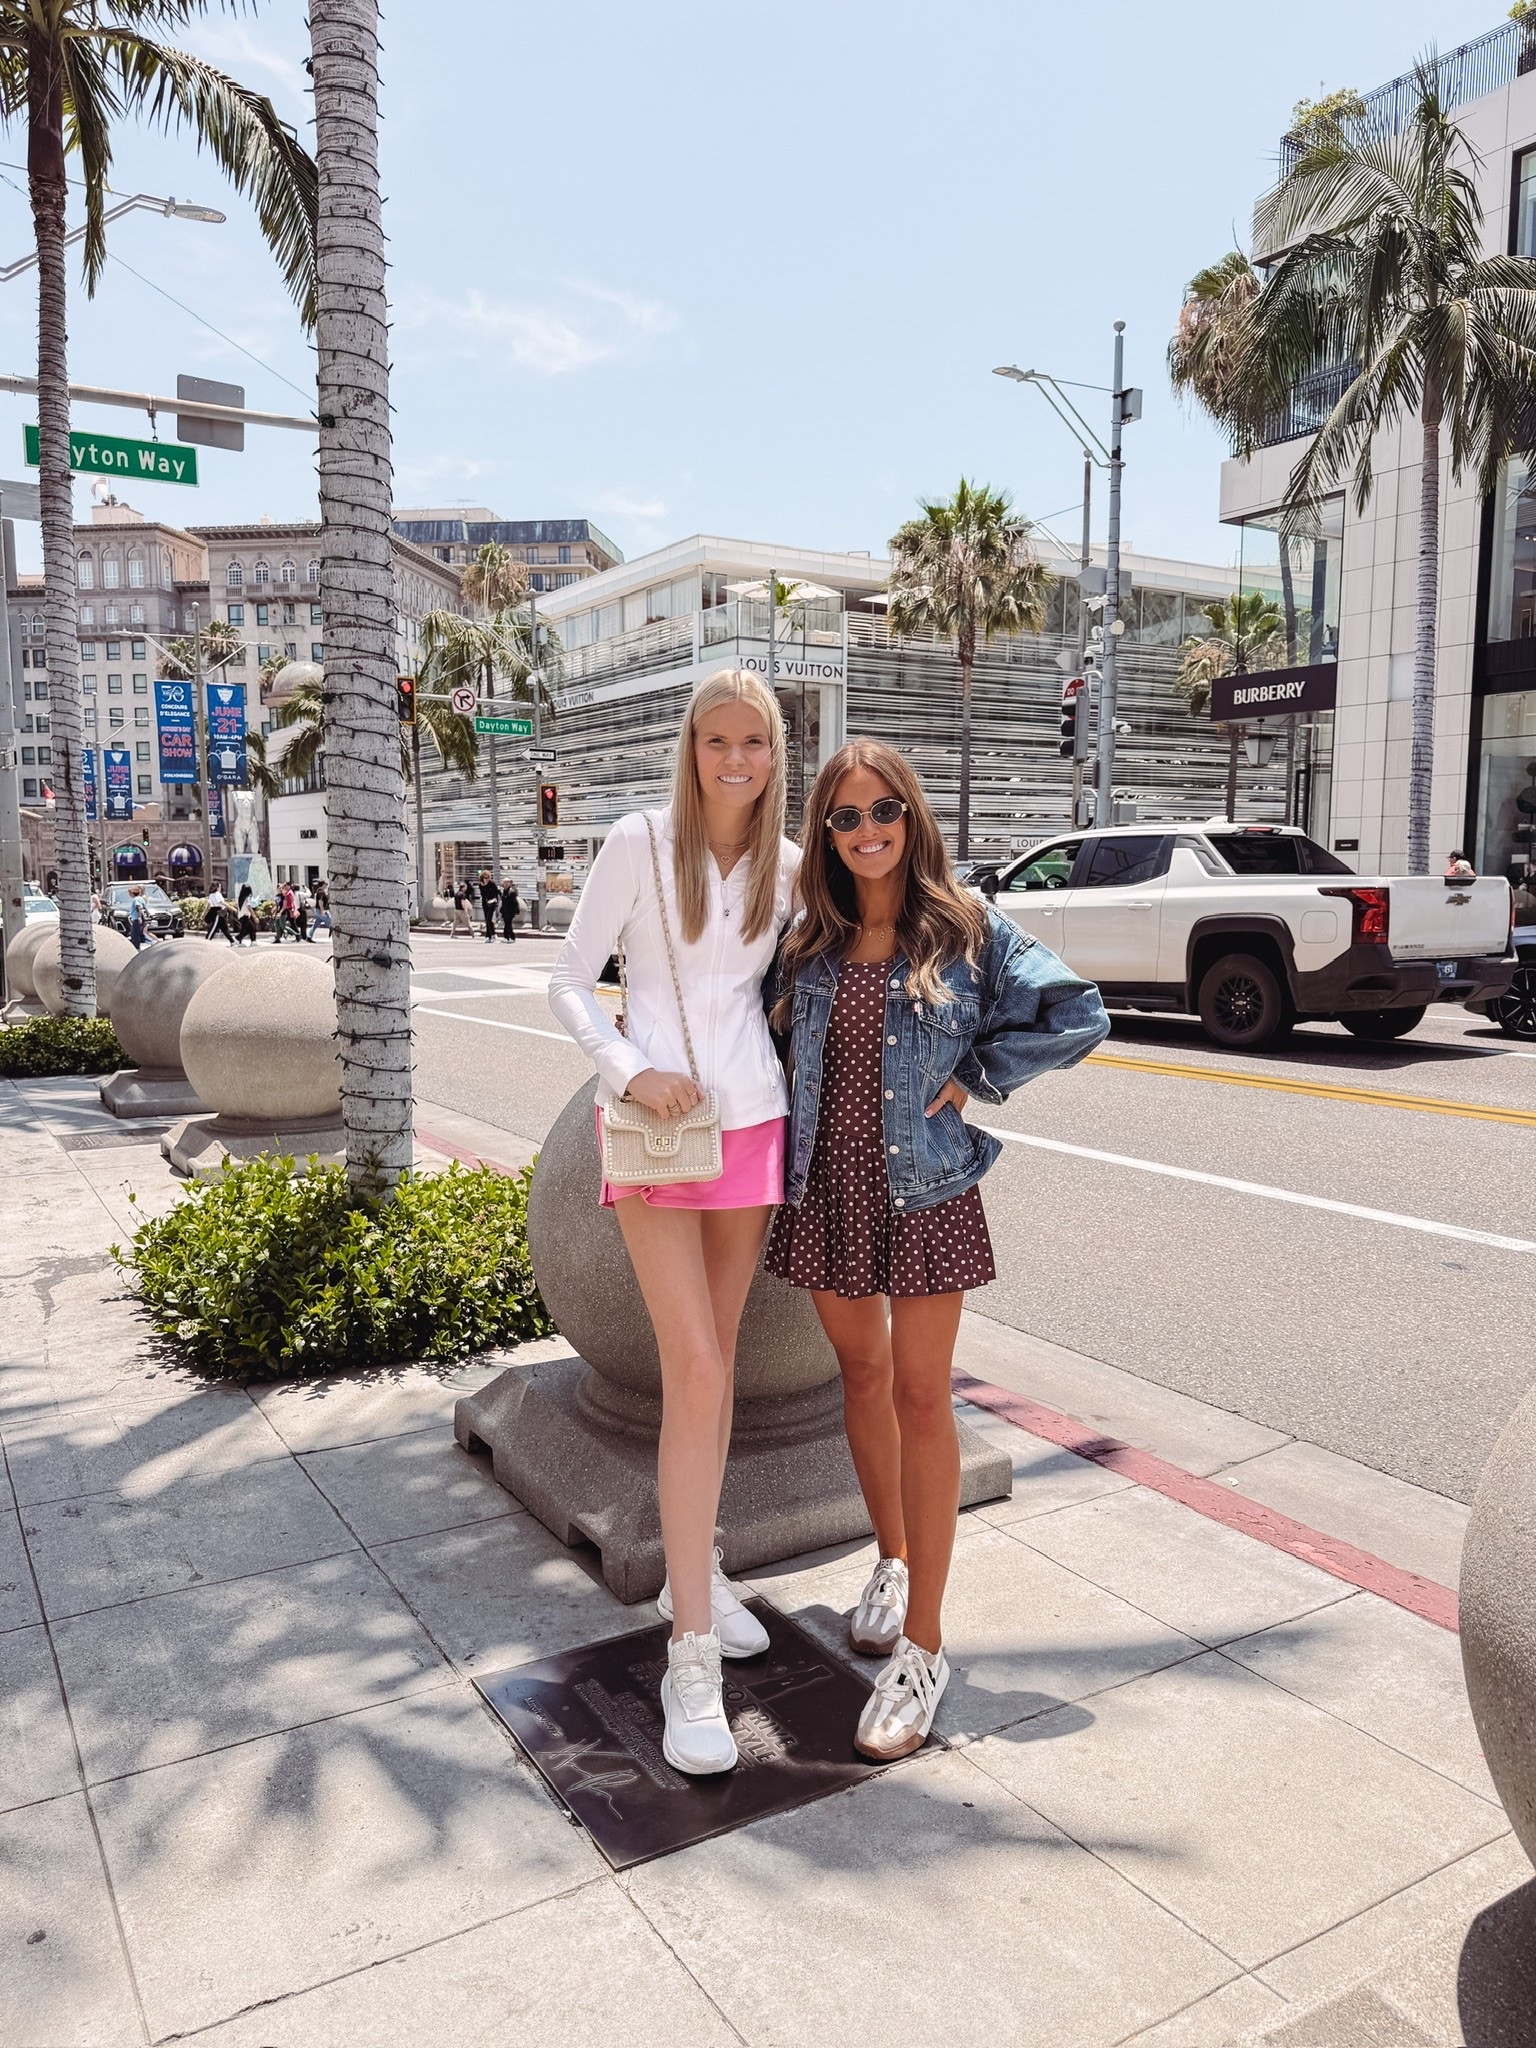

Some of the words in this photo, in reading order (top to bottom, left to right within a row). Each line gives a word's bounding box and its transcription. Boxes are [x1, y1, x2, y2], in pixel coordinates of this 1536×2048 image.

[72, 443, 129, 468] yton
[138, 450, 185, 480] Way
[740, 658, 780, 674] LOUS
[785, 661, 843, 679] VUITTON
[1233, 681, 1306, 705] BURBERRY
[211, 706, 242, 718] JUNE
[217, 718, 237, 733] 21
[479, 720, 510, 731] Dayton
[511, 722, 529, 733] Way
[161, 733, 193, 747] CAR
[162, 747, 193, 758] SHOW
[1017, 839, 1044, 847] LOUI
[616, 1692, 653, 1723] HERB
[737, 1702, 797, 1749] DRIVE
[729, 1716, 779, 1764] STYLE
